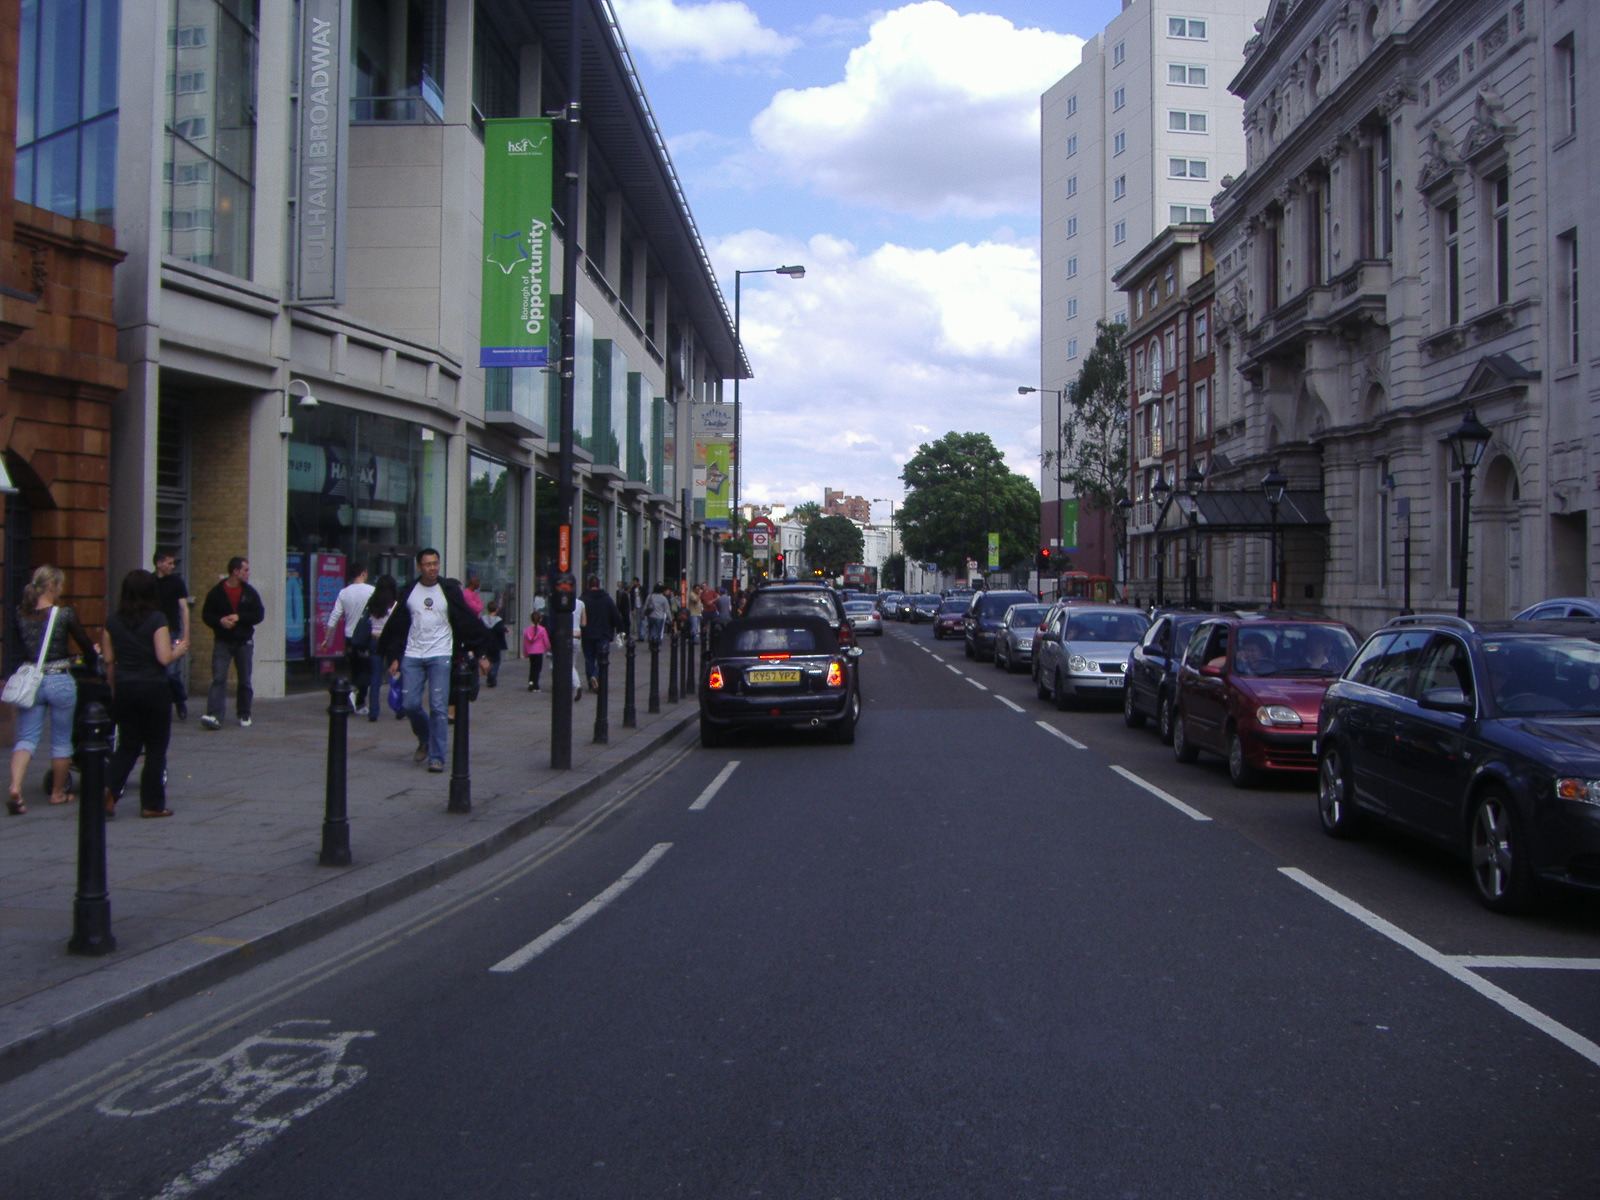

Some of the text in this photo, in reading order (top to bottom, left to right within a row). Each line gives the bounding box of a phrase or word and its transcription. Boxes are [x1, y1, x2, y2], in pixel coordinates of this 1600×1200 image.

[306, 17, 331, 273] FULHAM BROADWAY
[521, 276, 535, 320] Borough of
[526, 218, 547, 334] Opportunity
[331, 462, 375, 484] HAAX
